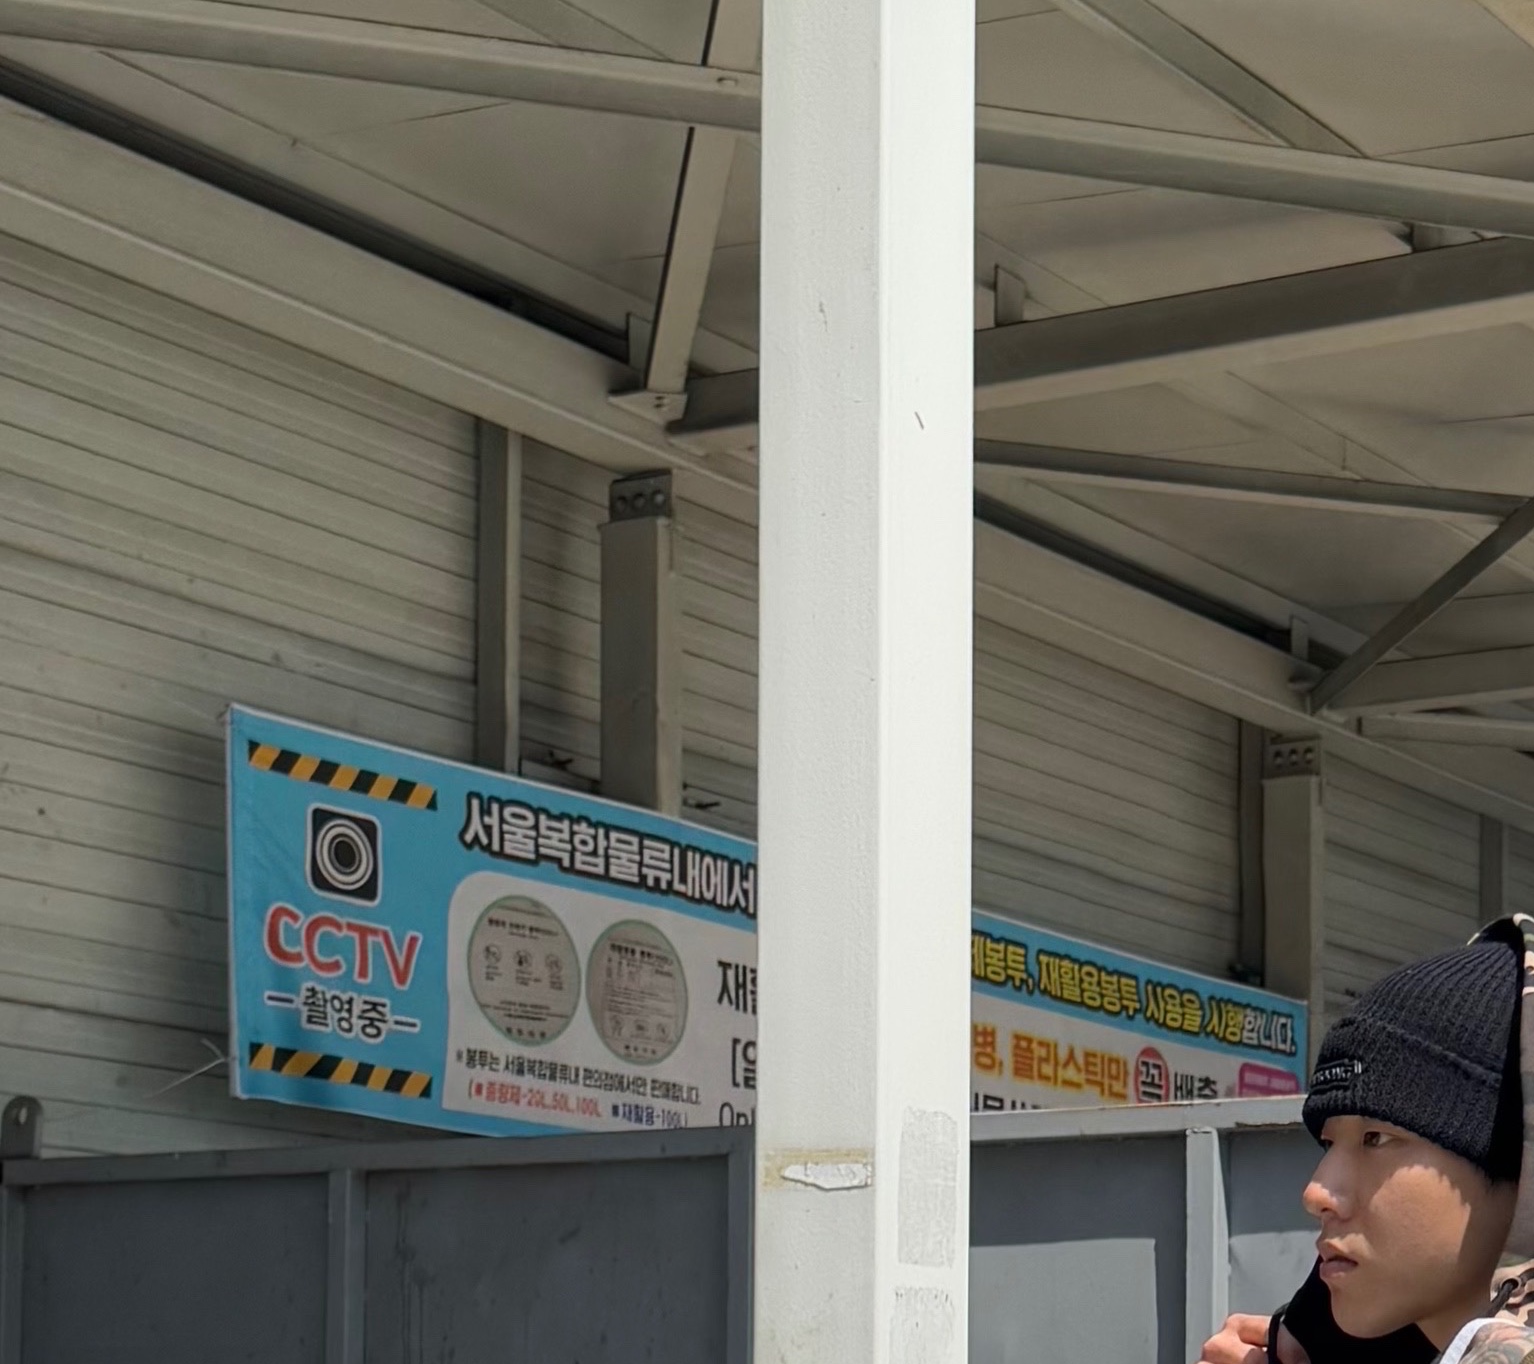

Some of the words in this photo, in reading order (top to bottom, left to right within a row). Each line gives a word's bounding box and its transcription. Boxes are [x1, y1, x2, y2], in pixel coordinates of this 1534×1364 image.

[460, 793, 757, 917] 서울복합물류내에서
[1037, 949, 1142, 1019] 재활용봉투
[265, 903, 422, 990] CCTV
[302, 985, 390, 1040] 촬영중
[717, 959, 757, 1016] 재
[503, 1054, 580, 1086] 서울복합물류내
[1012, 1031, 1131, 1101] 플라스틱만
